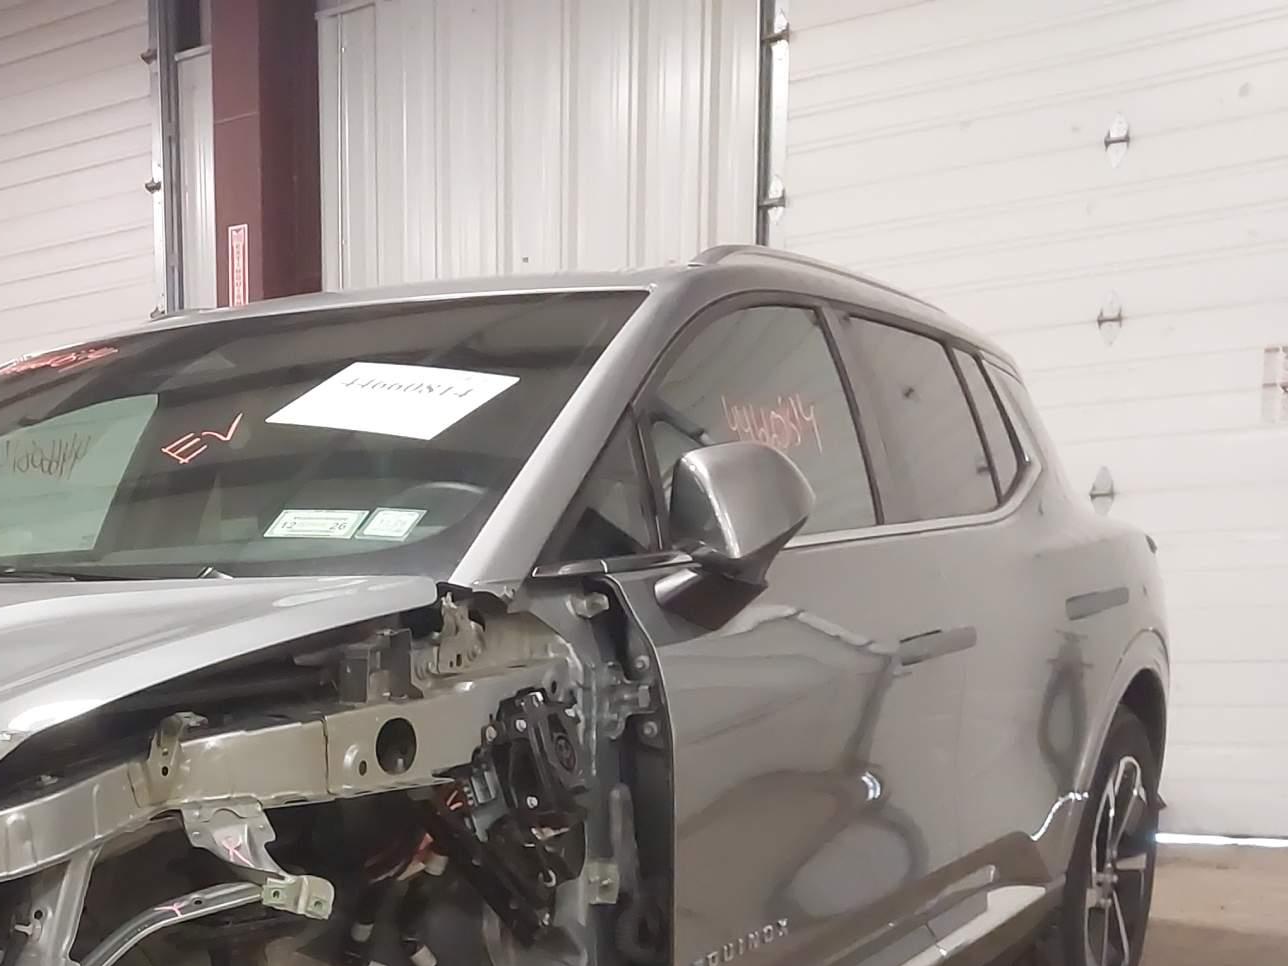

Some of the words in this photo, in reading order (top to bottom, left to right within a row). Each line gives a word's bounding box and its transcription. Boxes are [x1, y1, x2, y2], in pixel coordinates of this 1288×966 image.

[160, 412, 244, 464] EV
[280, 520, 297, 529] 12
[328, 521, 349, 531] 26
